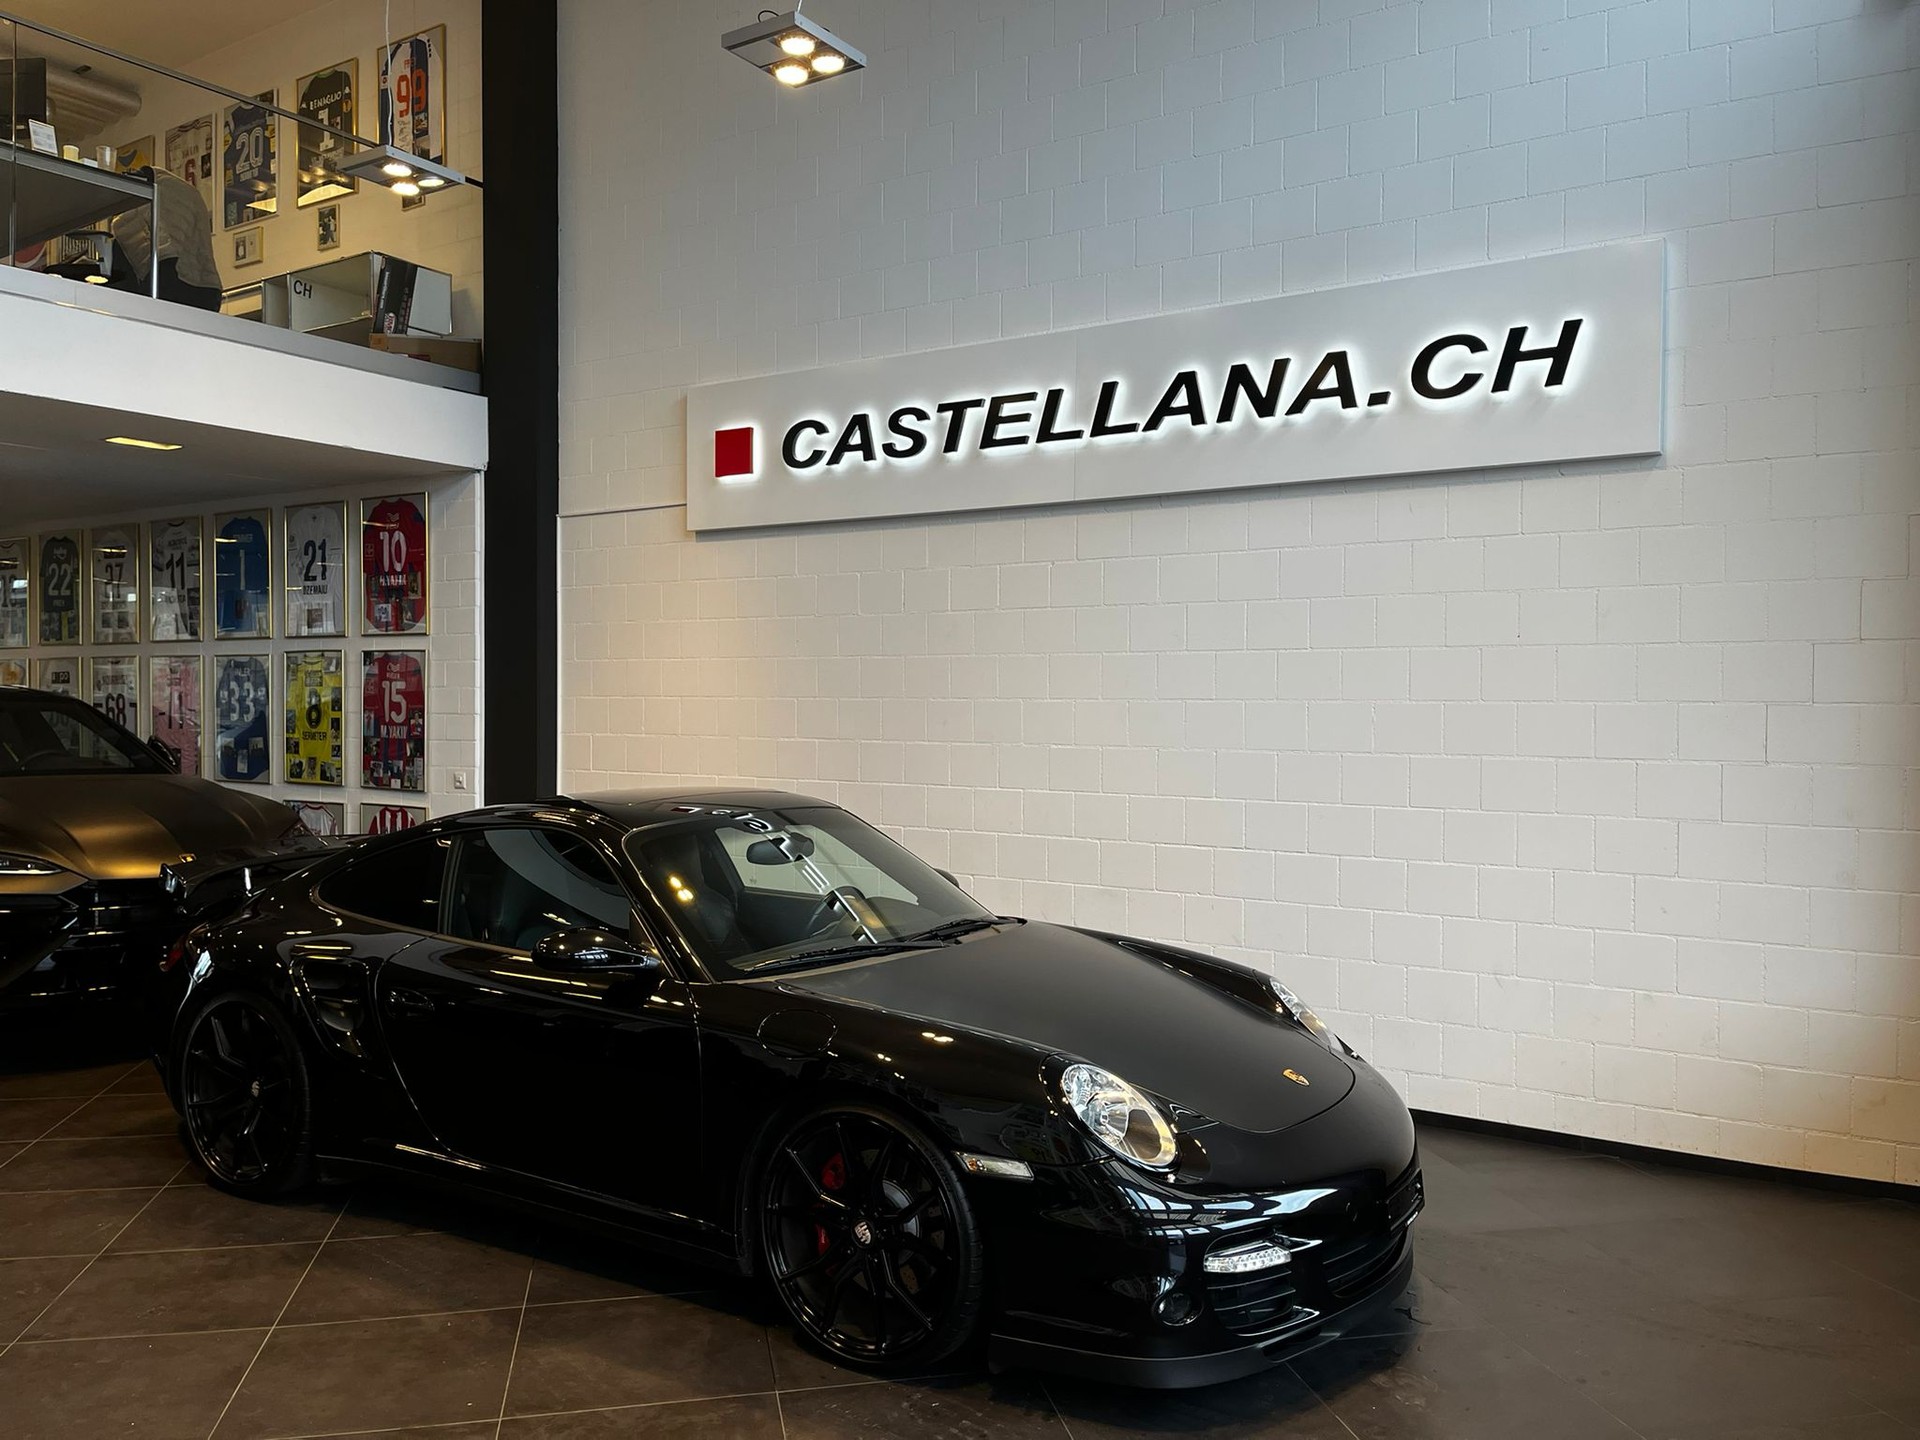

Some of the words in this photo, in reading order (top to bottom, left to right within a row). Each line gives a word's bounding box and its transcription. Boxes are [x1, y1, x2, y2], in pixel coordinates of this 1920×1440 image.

[309, 90, 342, 110] BENAGLIO
[397, 68, 426, 117] 99
[318, 107, 335, 150] 1
[236, 126, 264, 174] 20
[293, 279, 313, 299] CH
[782, 318, 1584, 469] CASTELLANA.CH
[165, 552, 186, 590] 11
[239, 549, 246, 590] 1
[303, 538, 328, 581] 21
[379, 530, 407, 572] 10
[48, 563, 72, 596] 22
[229, 680, 255, 722] 33
[381, 680, 407, 723] 15
